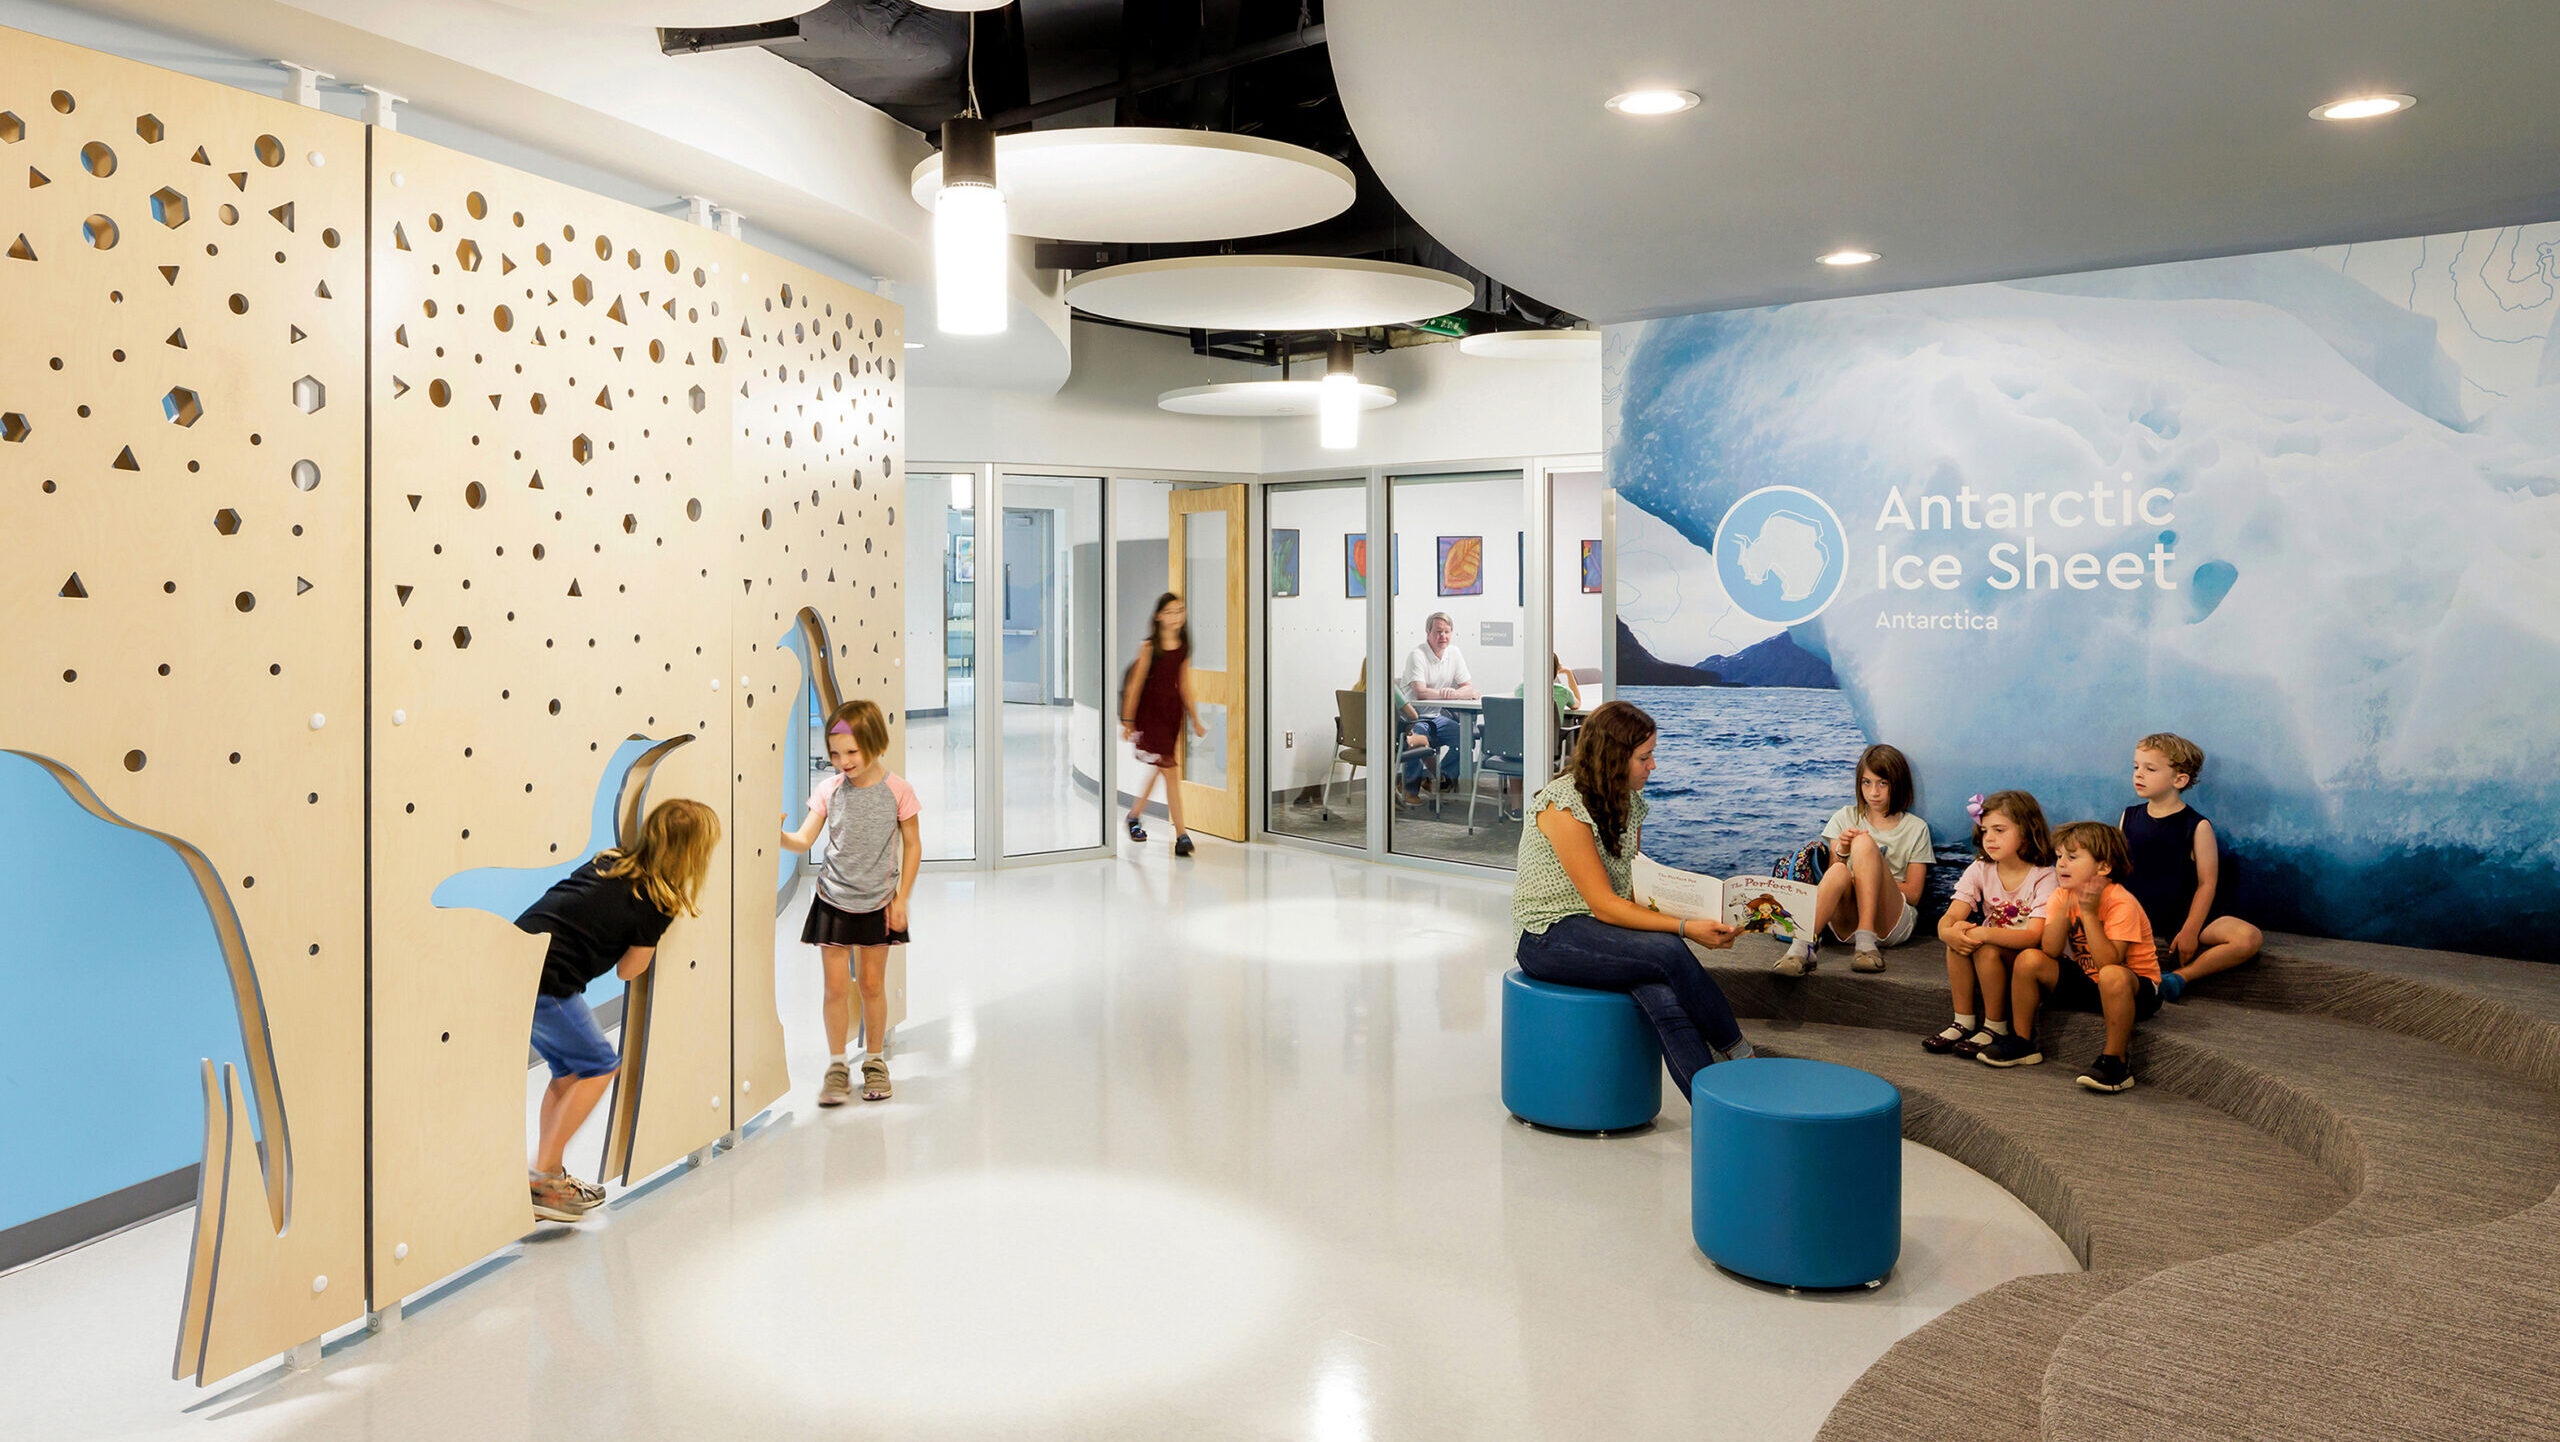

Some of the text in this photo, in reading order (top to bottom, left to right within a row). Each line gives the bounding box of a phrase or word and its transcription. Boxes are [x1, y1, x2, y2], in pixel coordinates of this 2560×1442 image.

[1875, 471, 2176, 531] Antarctic
[1878, 536, 2177, 590] Ice Sheet
[1875, 609, 1999, 630] Antarctica
[1744, 877, 1793, 893] Perfect
